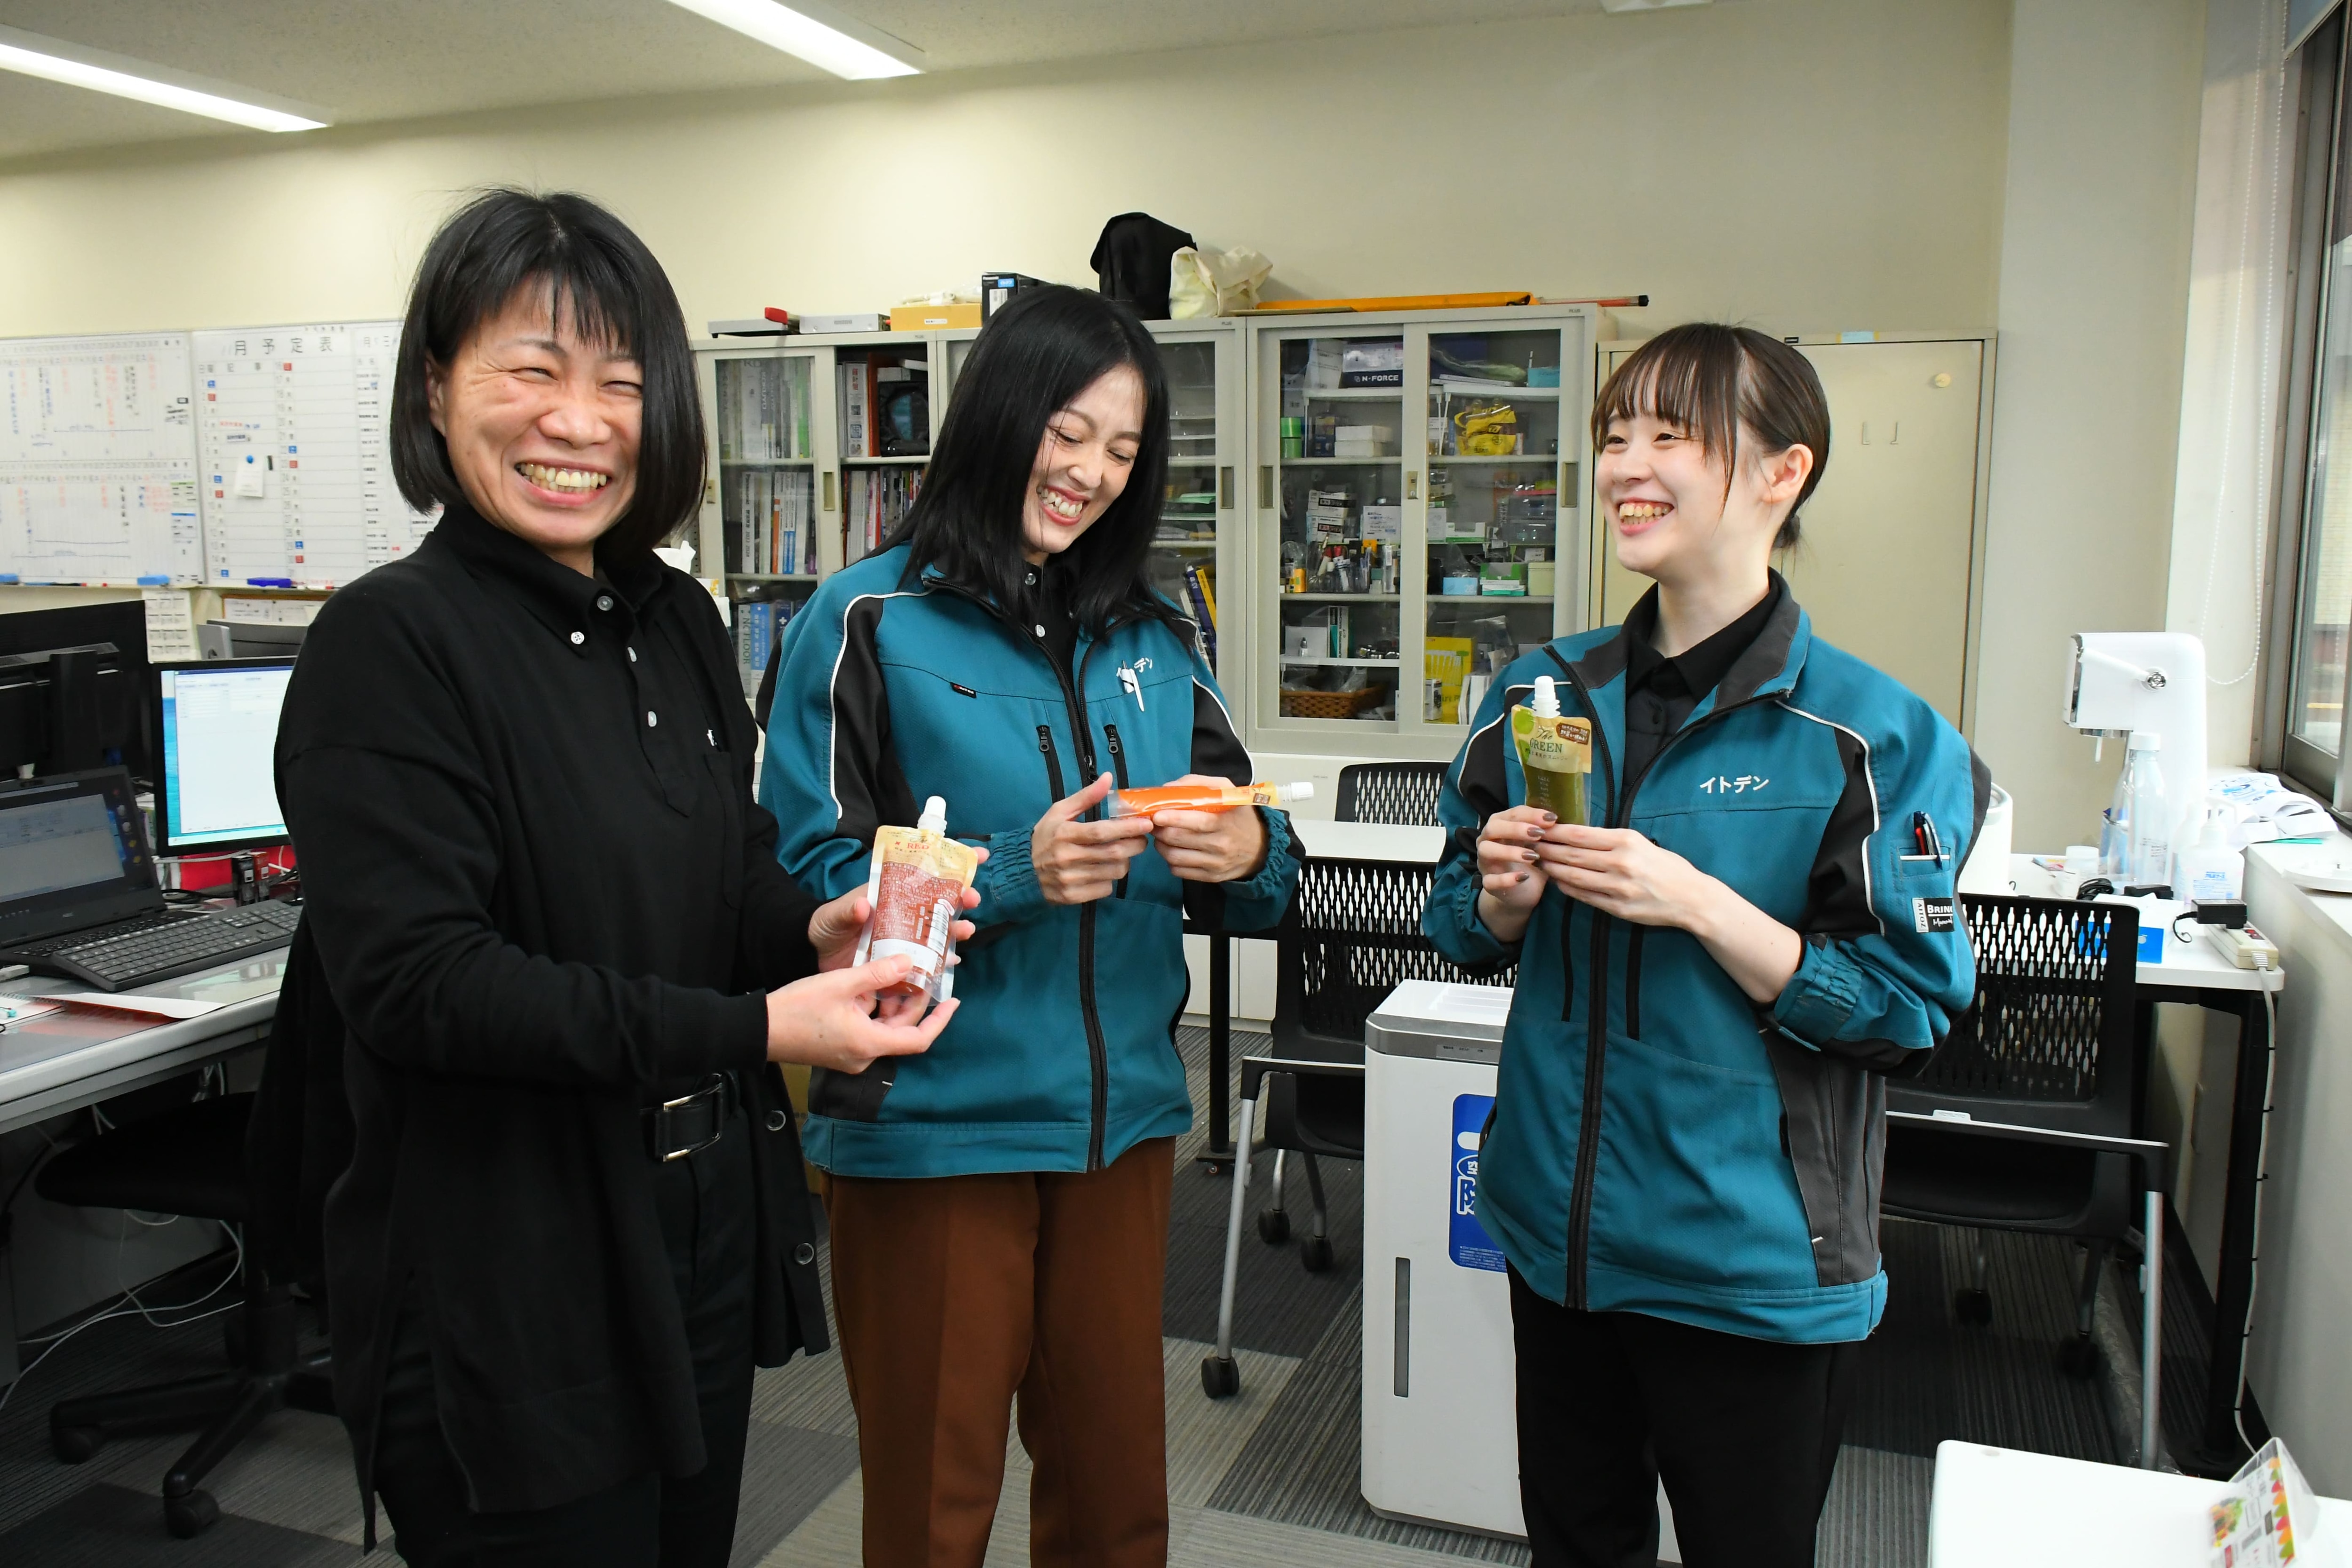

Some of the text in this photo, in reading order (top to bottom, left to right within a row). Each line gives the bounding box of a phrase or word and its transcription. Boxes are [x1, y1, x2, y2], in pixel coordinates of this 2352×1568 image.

[1536, 727, 1553, 740] The
[1530, 738, 1563, 753] GREEN
[1700, 775, 1770, 794] イトデン
